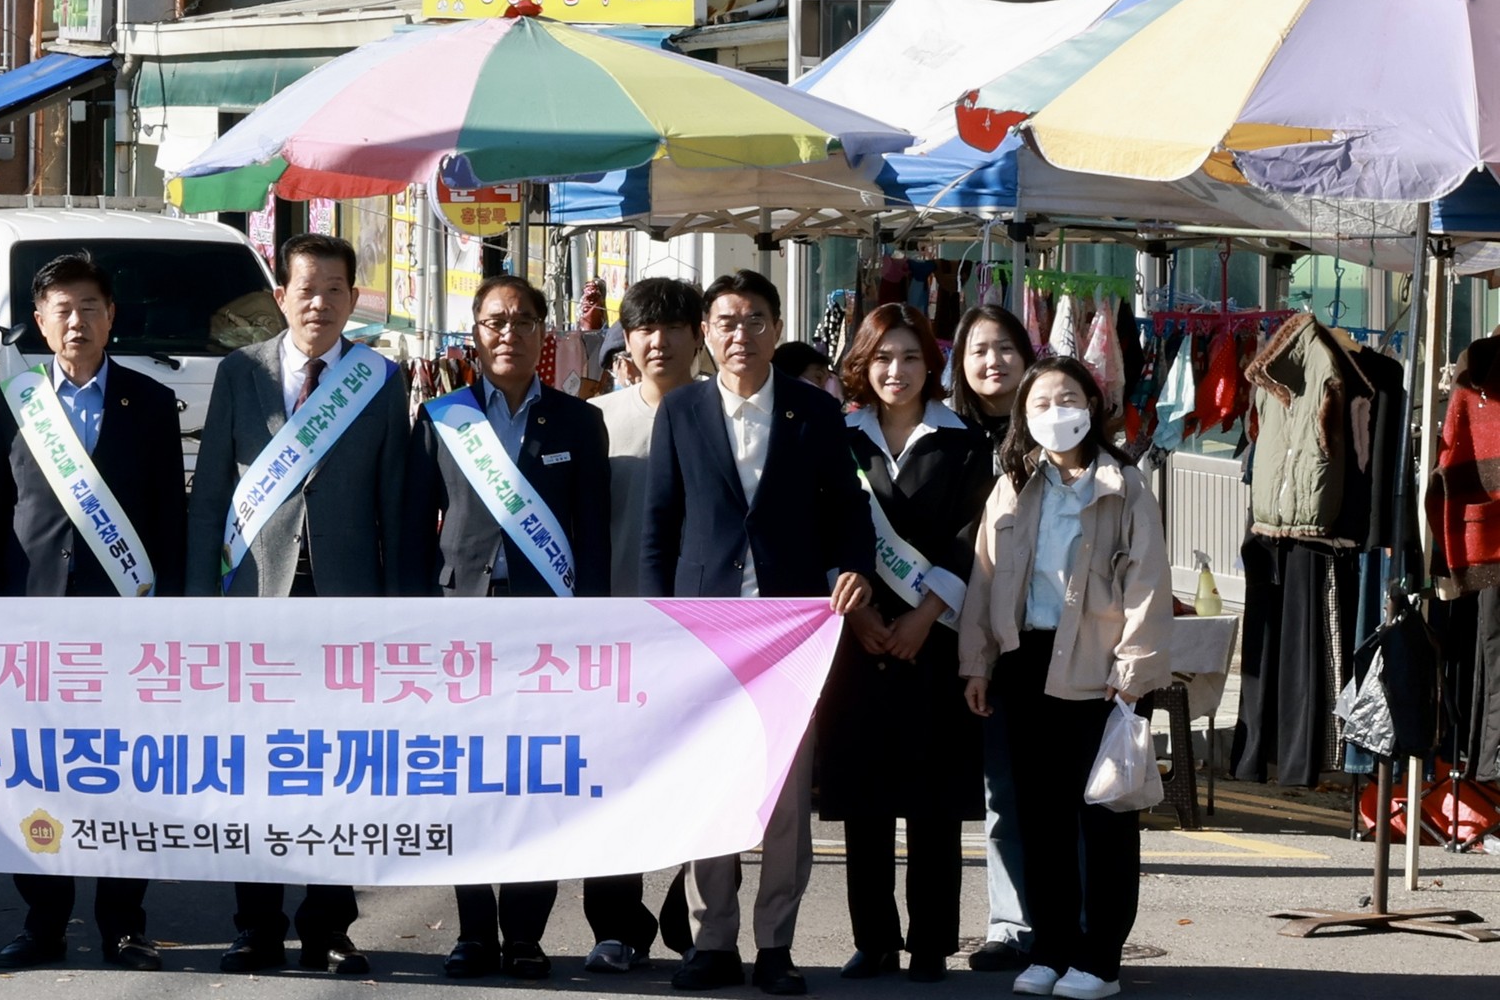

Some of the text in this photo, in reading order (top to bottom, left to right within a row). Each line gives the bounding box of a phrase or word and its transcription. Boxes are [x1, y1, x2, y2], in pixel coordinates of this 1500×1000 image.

[342, 362, 373, 395] 우리
[130, 640, 300, 704] 살리는
[323, 640, 498, 705] 따뜻한
[516, 641, 648, 709] 소비,
[266, 728, 604, 799] 함께합니다.
[71, 818, 455, 858] 전라남도의회 농수산위원회
